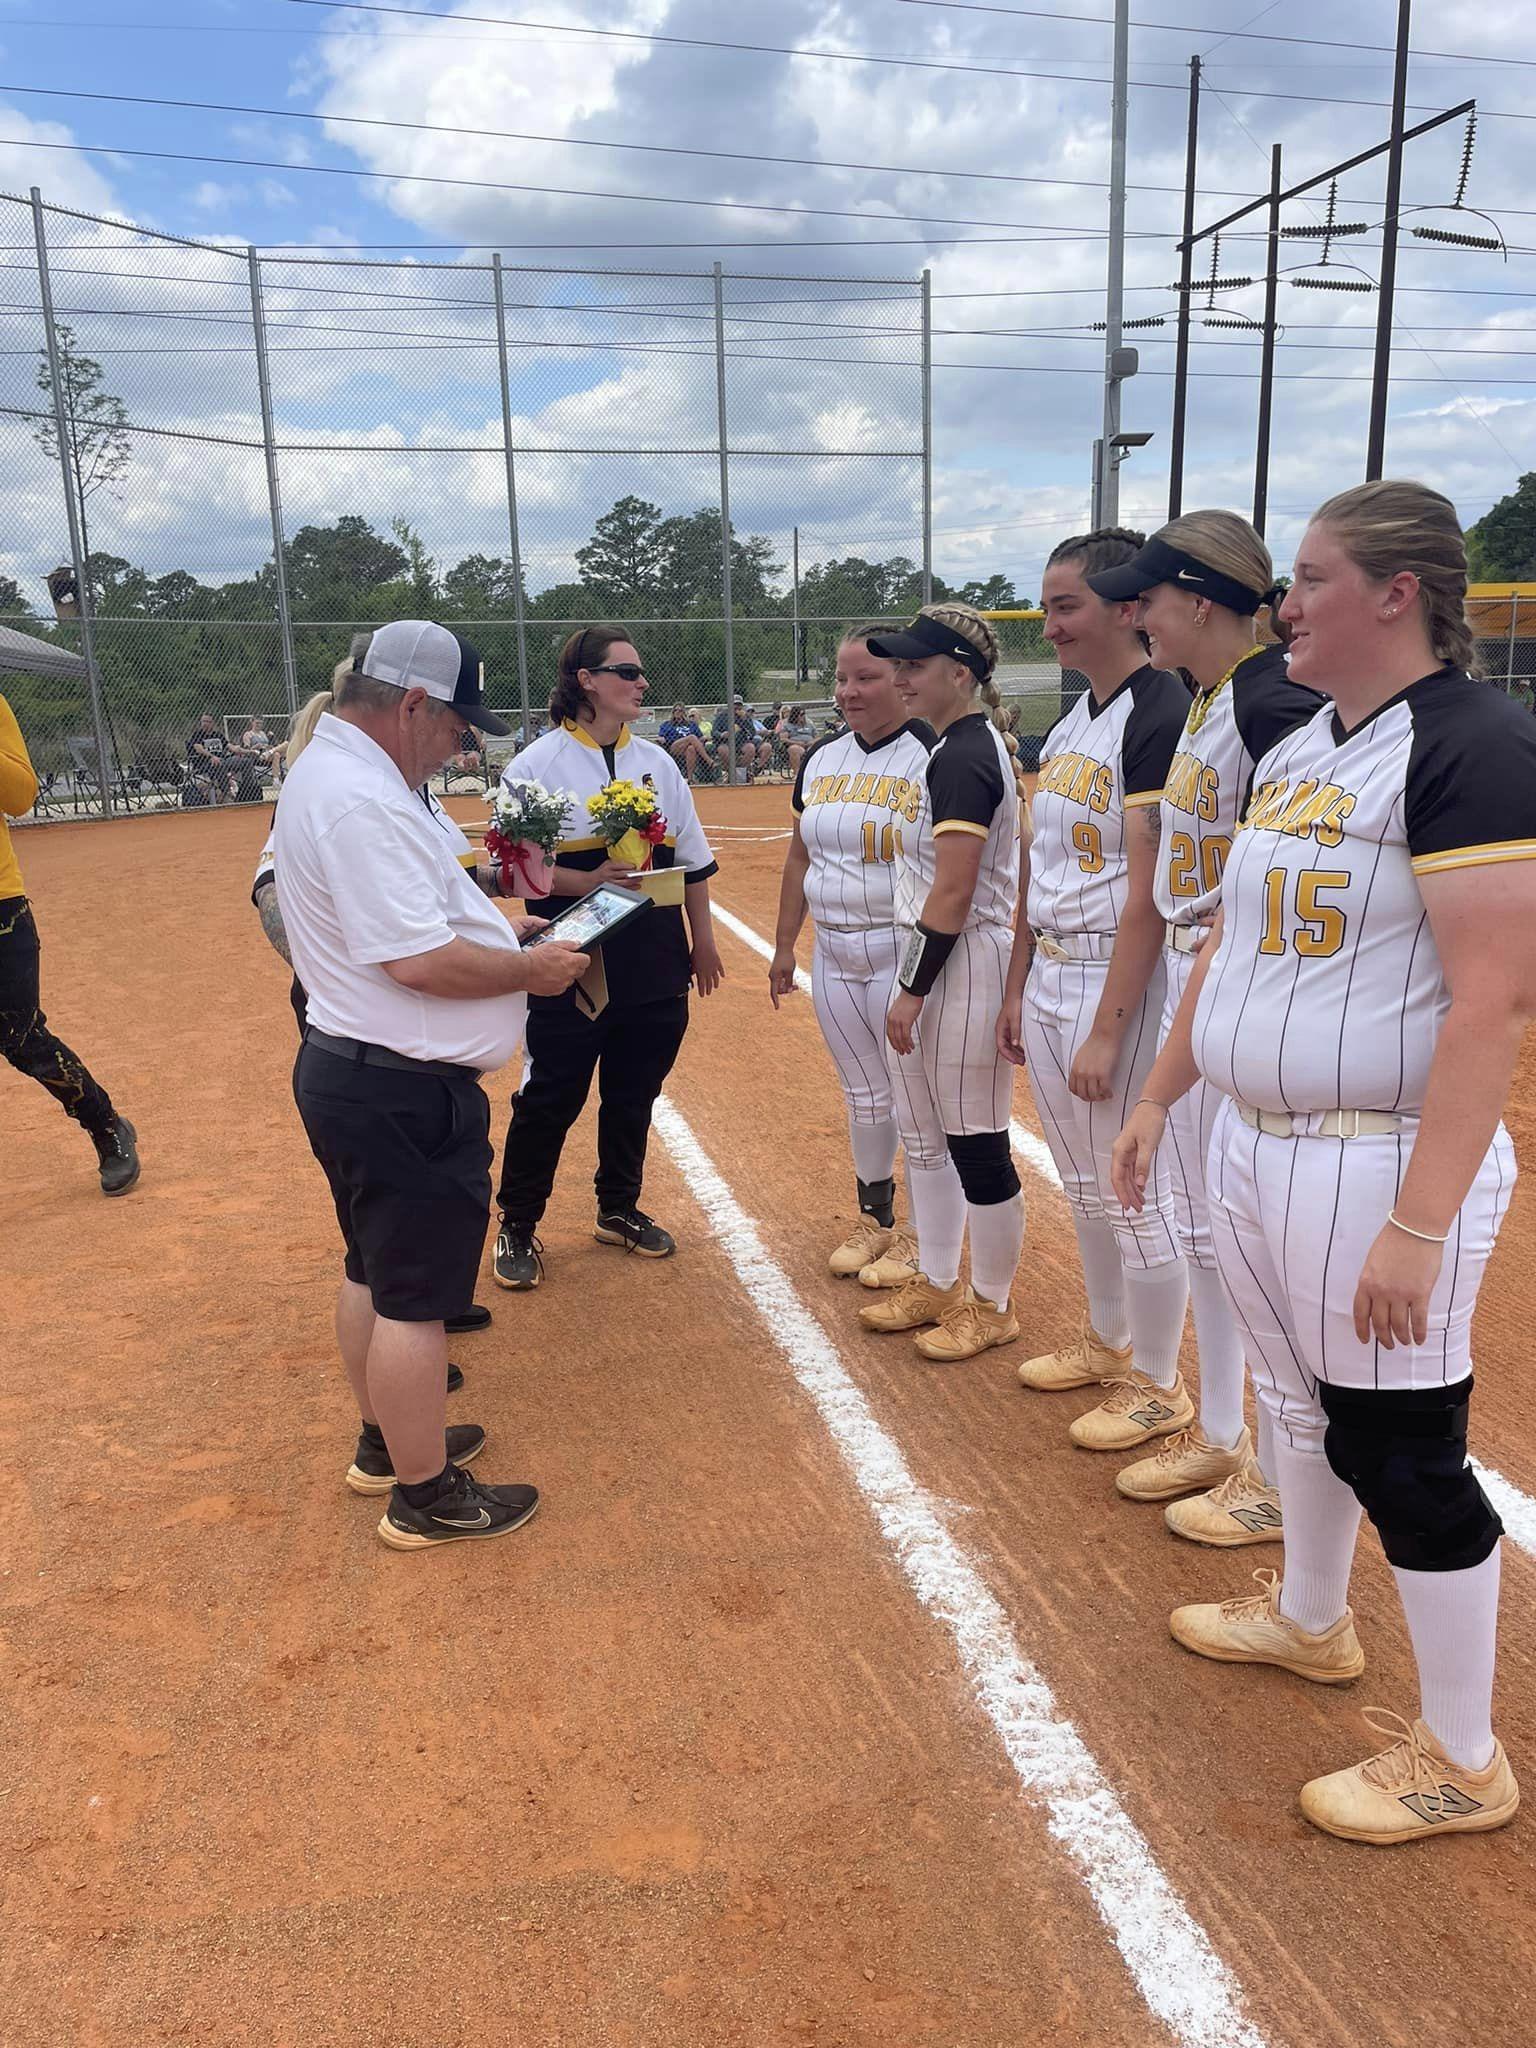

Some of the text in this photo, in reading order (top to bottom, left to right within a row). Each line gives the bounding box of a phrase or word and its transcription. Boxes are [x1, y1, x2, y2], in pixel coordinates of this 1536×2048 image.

[1072, 822, 1106, 874] 9
[1169, 831, 1233, 898] 20
[1259, 867, 1352, 958] 15
